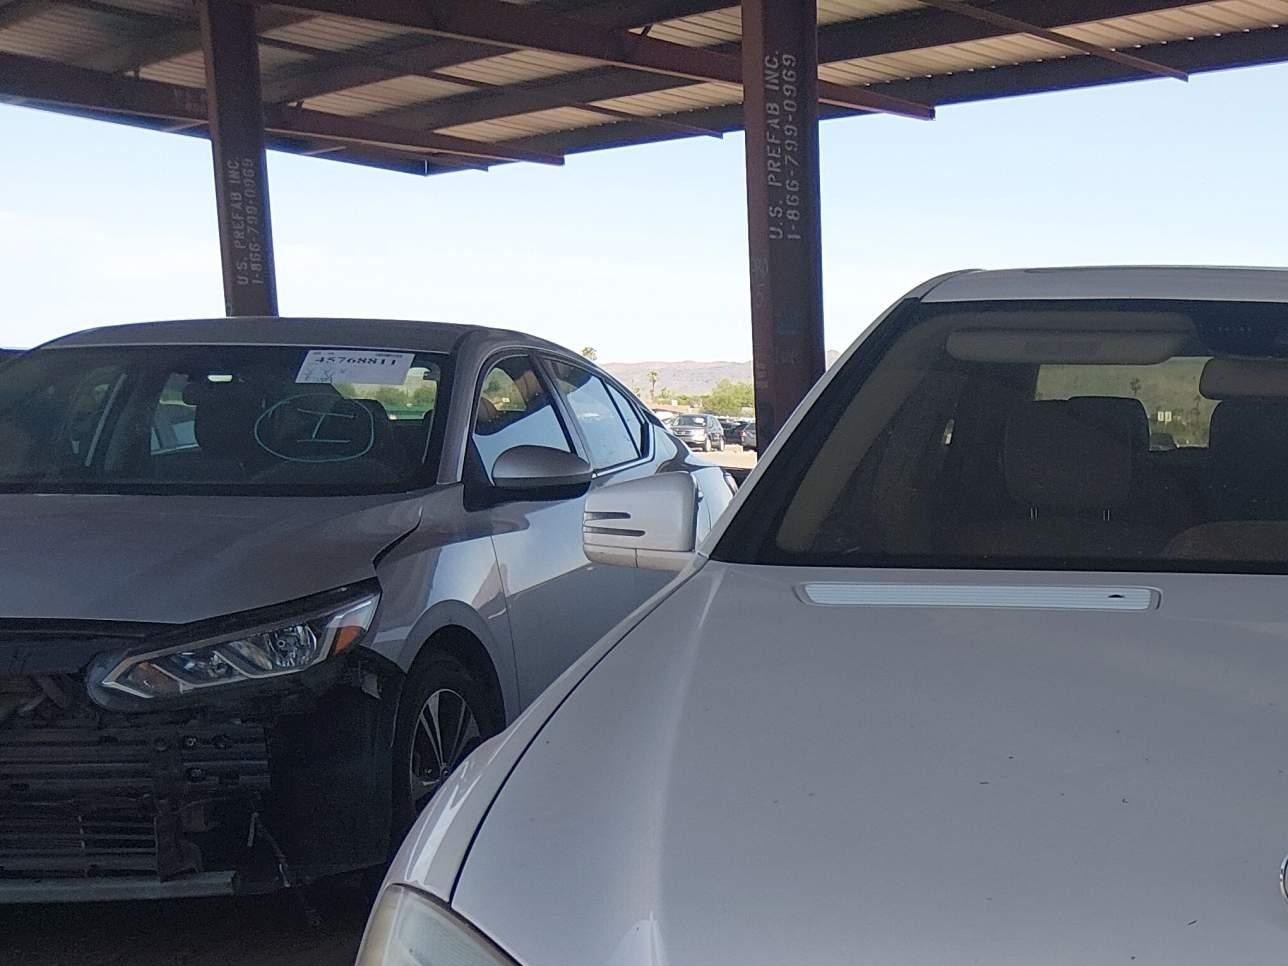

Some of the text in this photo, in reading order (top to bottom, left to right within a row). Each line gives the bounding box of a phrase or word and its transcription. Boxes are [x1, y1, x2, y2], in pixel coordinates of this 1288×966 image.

[764, 50, 784, 240] U.S. PREFAB INC.
[782, 53, 801, 240] 1-866-799-0969
